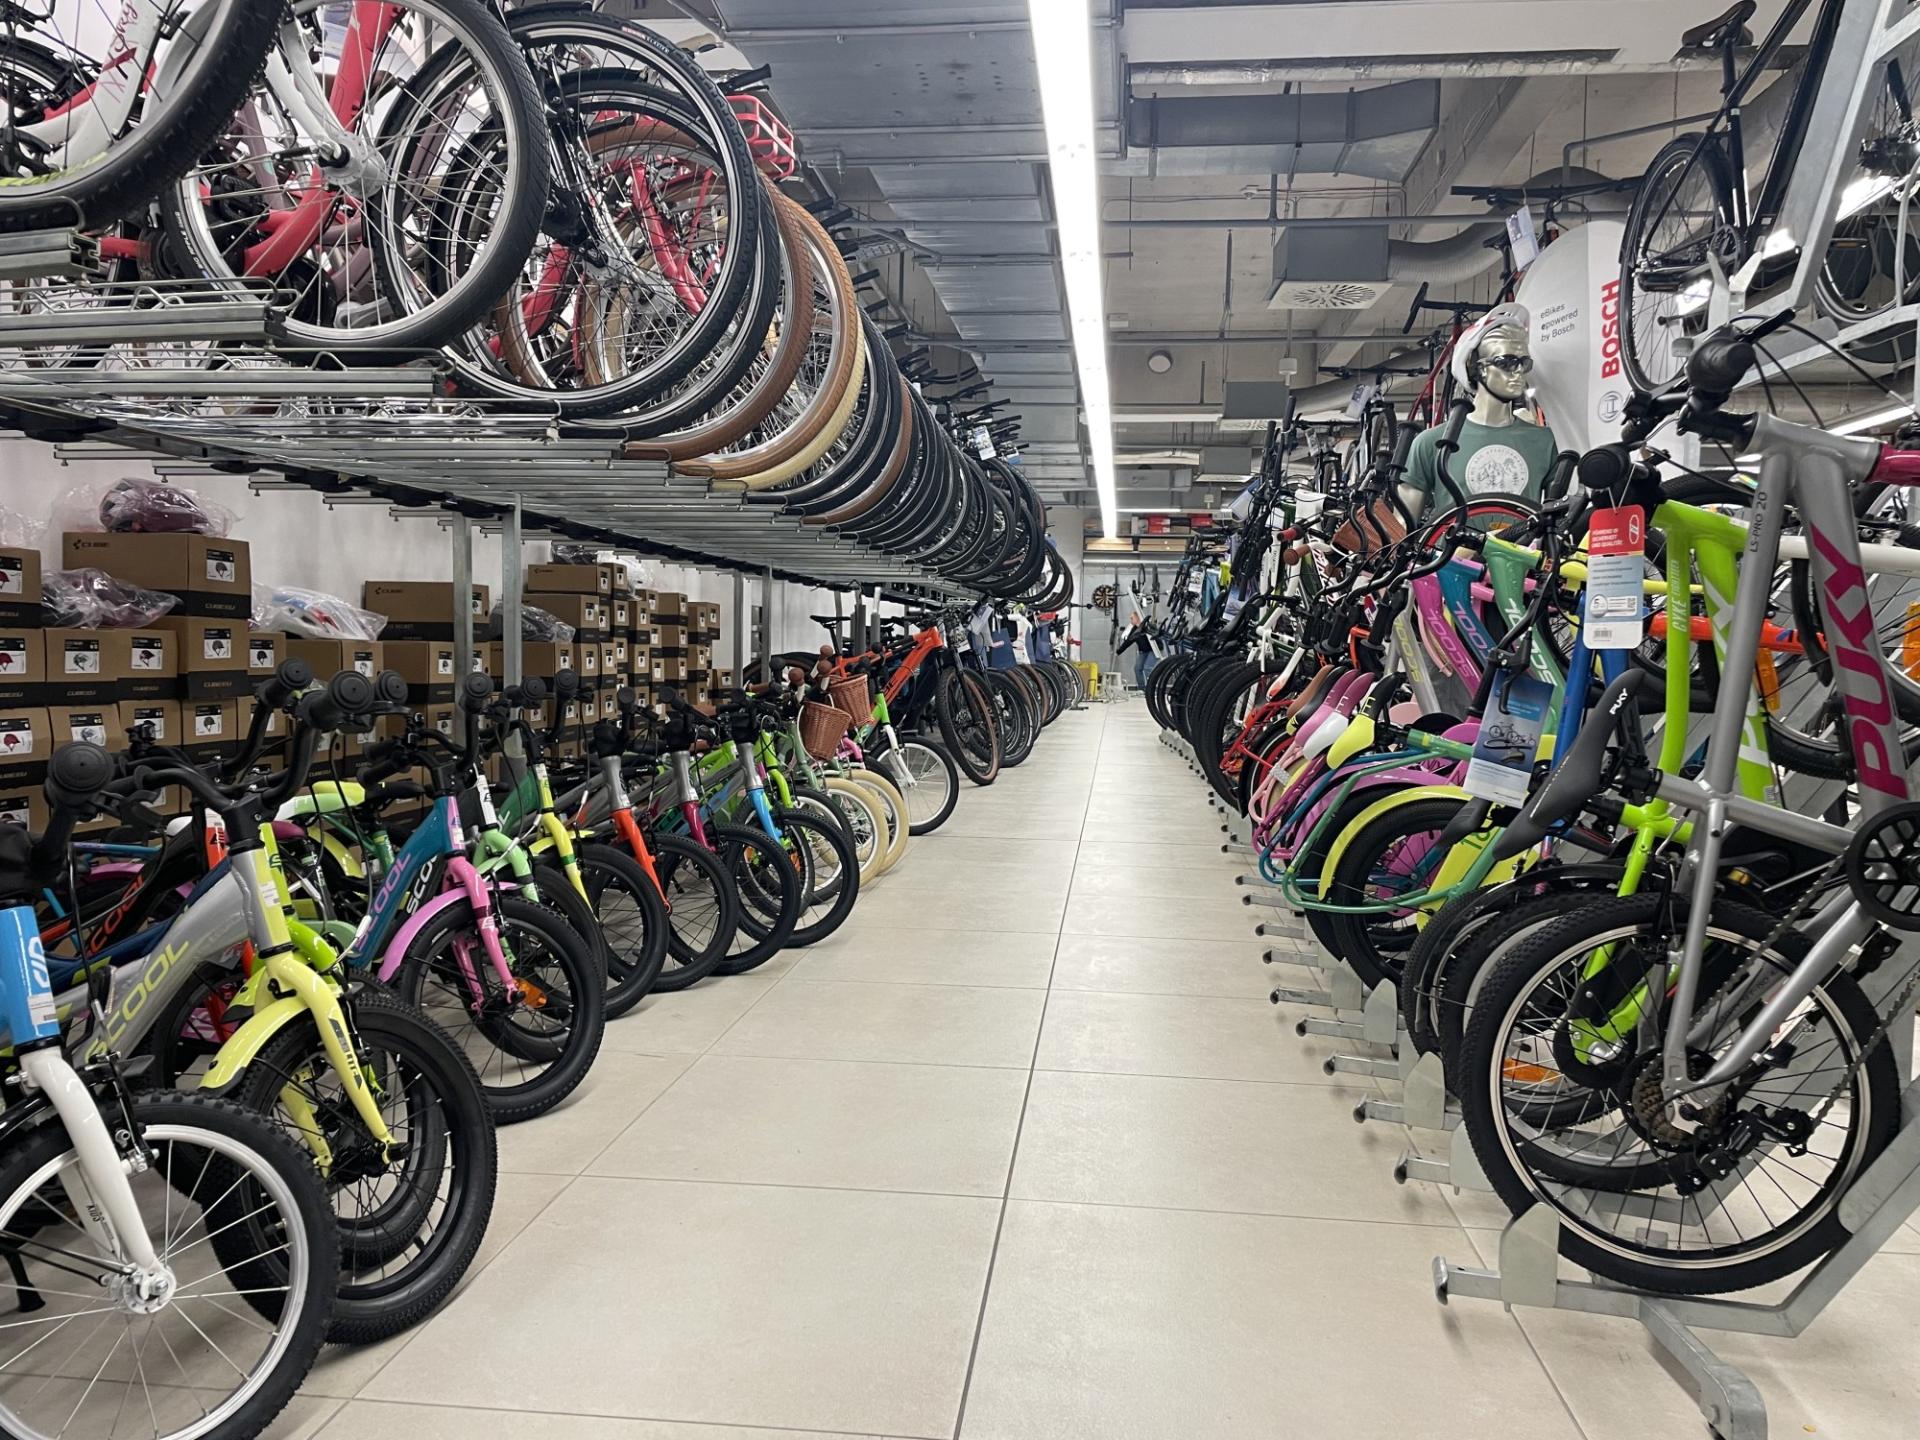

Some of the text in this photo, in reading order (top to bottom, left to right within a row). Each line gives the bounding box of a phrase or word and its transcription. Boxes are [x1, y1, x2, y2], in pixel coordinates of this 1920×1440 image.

[1540, 303, 1566, 319] eBikes
[1541, 308, 1579, 330] epowered
[1541, 322, 1576, 342] by Bosch
[1601, 279, 1620, 379] BOSCH
[1749, 491, 1768, 552] LS-PRO 20
[1425, 608, 1476, 678] SCOOL
[1504, 598, 1559, 687] SCOL
[1672, 600, 1687, 633] CYKE
[1394, 618, 1424, 683] SCOOL
[1810, 521, 1909, 801] PUKY
[1609, 688, 1628, 715] PUKY
[406, 855, 438, 916] SCO
